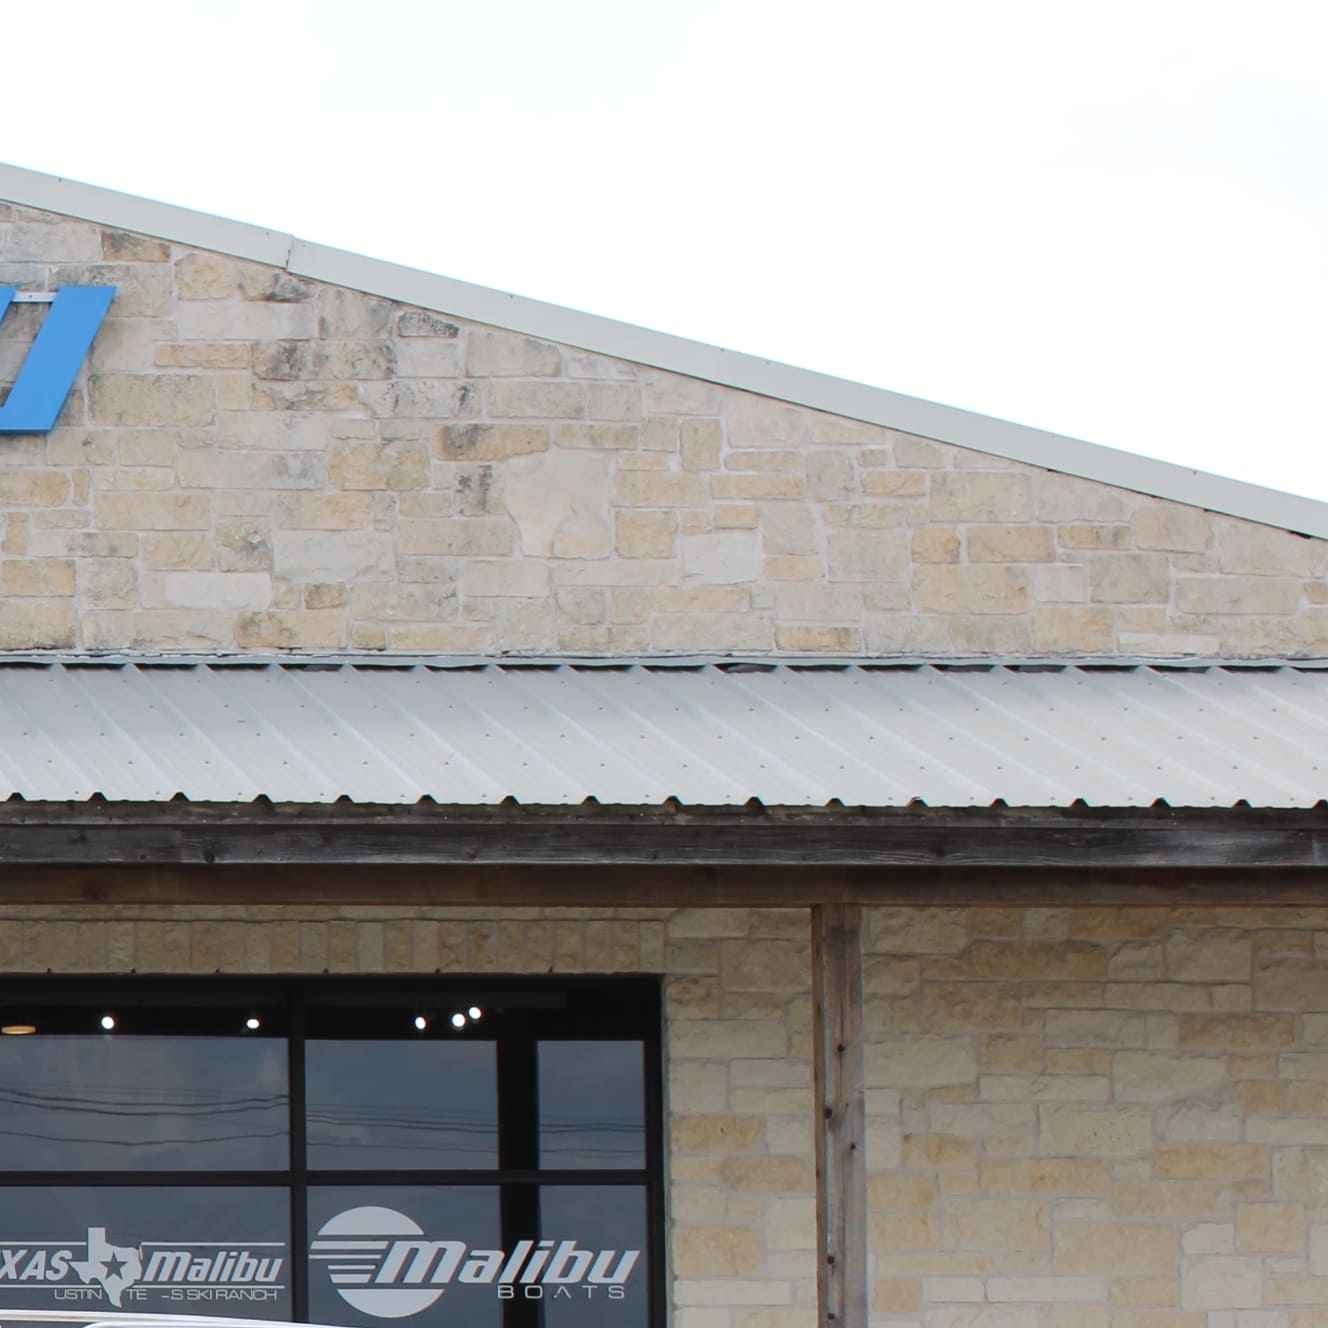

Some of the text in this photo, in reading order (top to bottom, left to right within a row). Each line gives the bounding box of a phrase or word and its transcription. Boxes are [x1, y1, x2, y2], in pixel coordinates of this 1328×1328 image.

[186, 1288, 213, 1300] SKI
[215, 1288, 278, 1300] RANCH
[497, 1285, 625, 1299] BOATS
